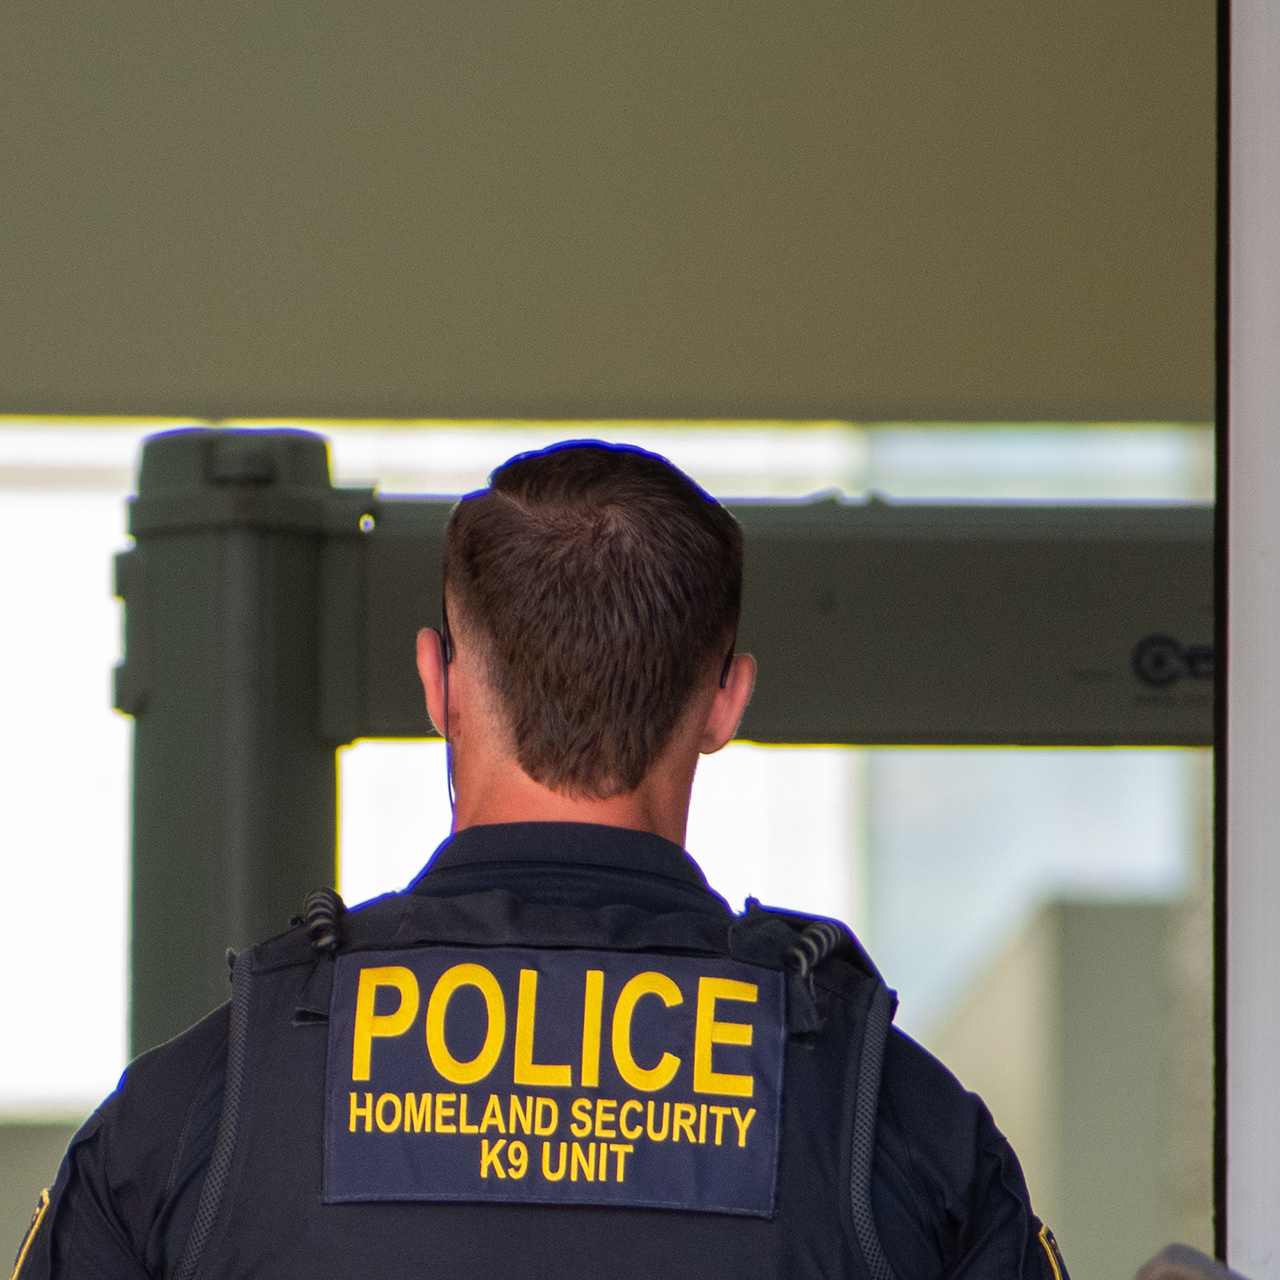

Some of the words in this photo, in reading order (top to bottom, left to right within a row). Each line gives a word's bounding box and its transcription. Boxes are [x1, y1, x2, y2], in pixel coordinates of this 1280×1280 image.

[352, 962, 758, 1097] POLICE
[349, 1091, 559, 1136] HOMELAND
[570, 1098, 756, 1147] SECURITY
[480, 1139, 528, 1179] K9
[542, 1142, 634, 1182] UNIT
